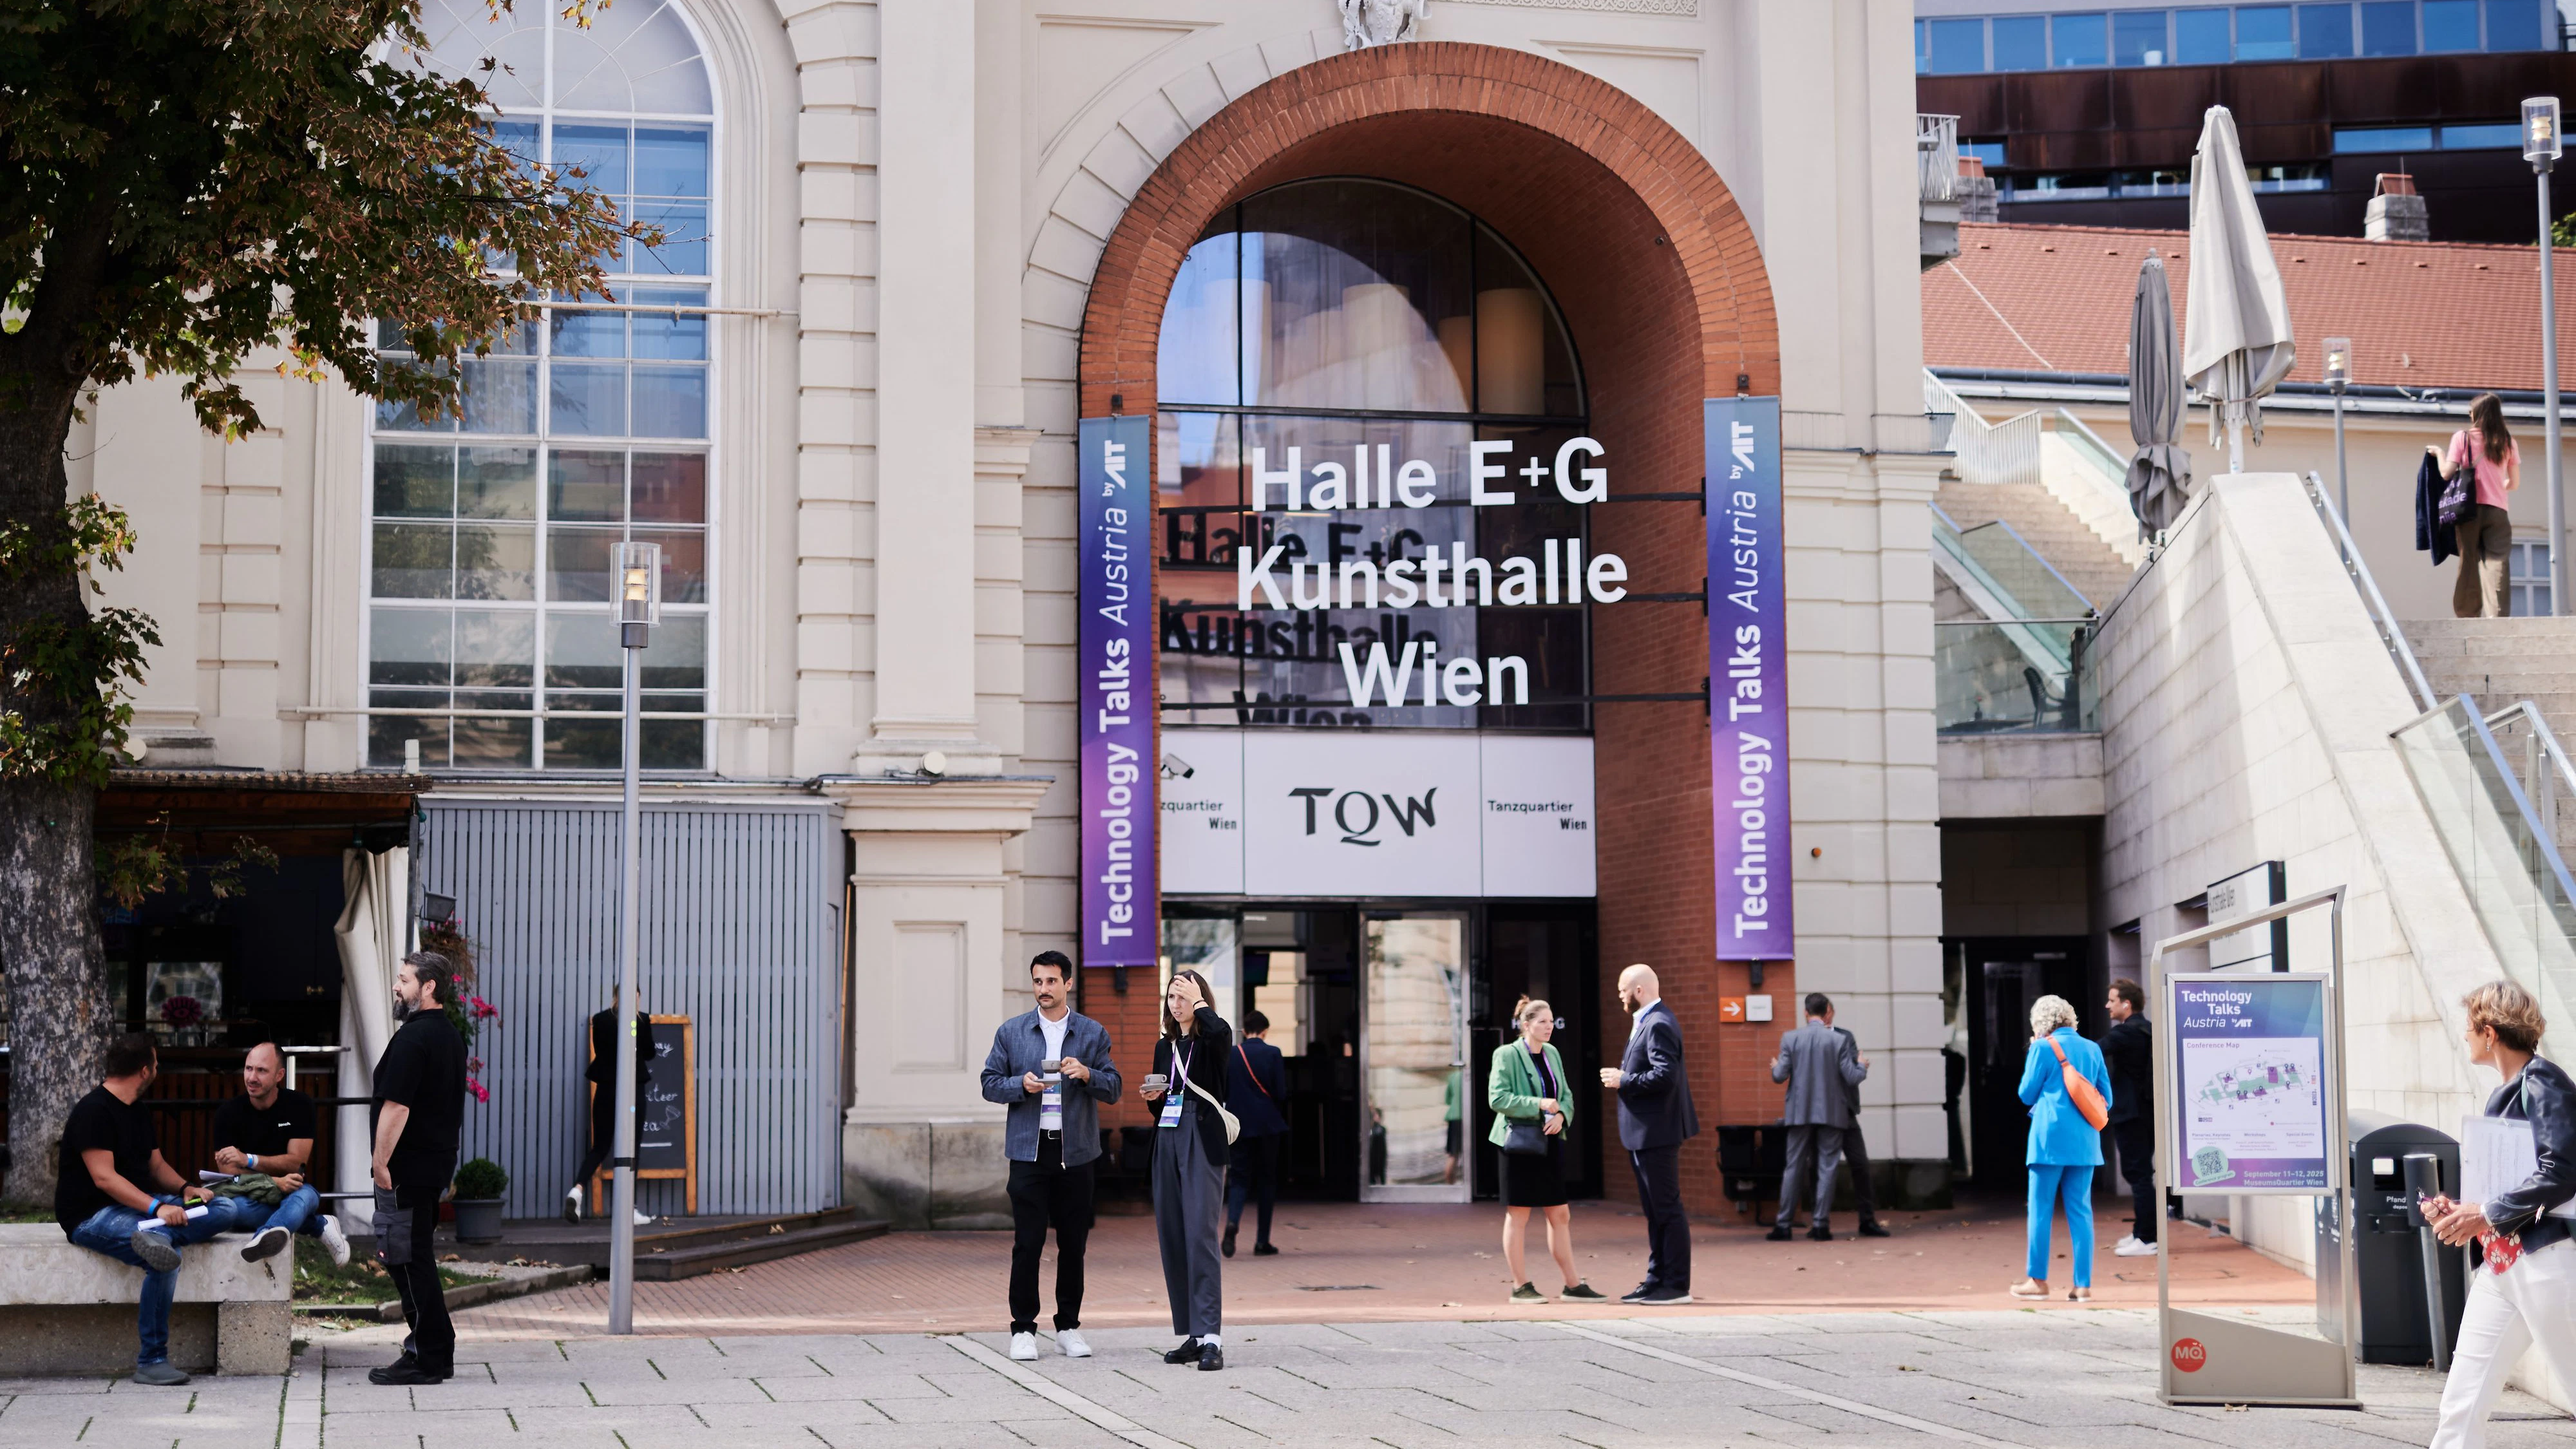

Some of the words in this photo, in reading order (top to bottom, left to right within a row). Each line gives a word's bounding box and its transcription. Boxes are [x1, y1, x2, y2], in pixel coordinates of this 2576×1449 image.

[1104, 440, 1126, 489] AIT
[1729, 464, 1743, 480] by
[1731, 421, 1755, 472] AIT
[1102, 482, 1115, 497] by
[1253, 444, 1437, 511] Halle
[1470, 437, 1607, 506] E+G
[1099, 507, 1128, 627] Austria
[1238, 538, 1628, 611] Kunsthalle
[1726, 490, 1759, 612] Austria
[1099, 638, 1130, 733] Talks
[1338, 642, 1528, 708] Wien
[1729, 624, 1761, 721] Talks
[1209, 818, 1236, 830] Wien
[1288, 787, 1438, 847] TQW
[1488, 800, 1573, 813] Tanzquartier
[1560, 818, 1587, 831] Wien
[1101, 743, 1139, 945] Technology
[1732, 731, 1772, 938] Technology
[2182, 990, 2252, 1004] Technology
[2184, 1017, 2226, 1028] Austria
[2235, 1019, 2253, 1027] AIT
[2208, 1003, 2241, 1015] Talks
[2175, 1346, 2203, 1359] MQ
